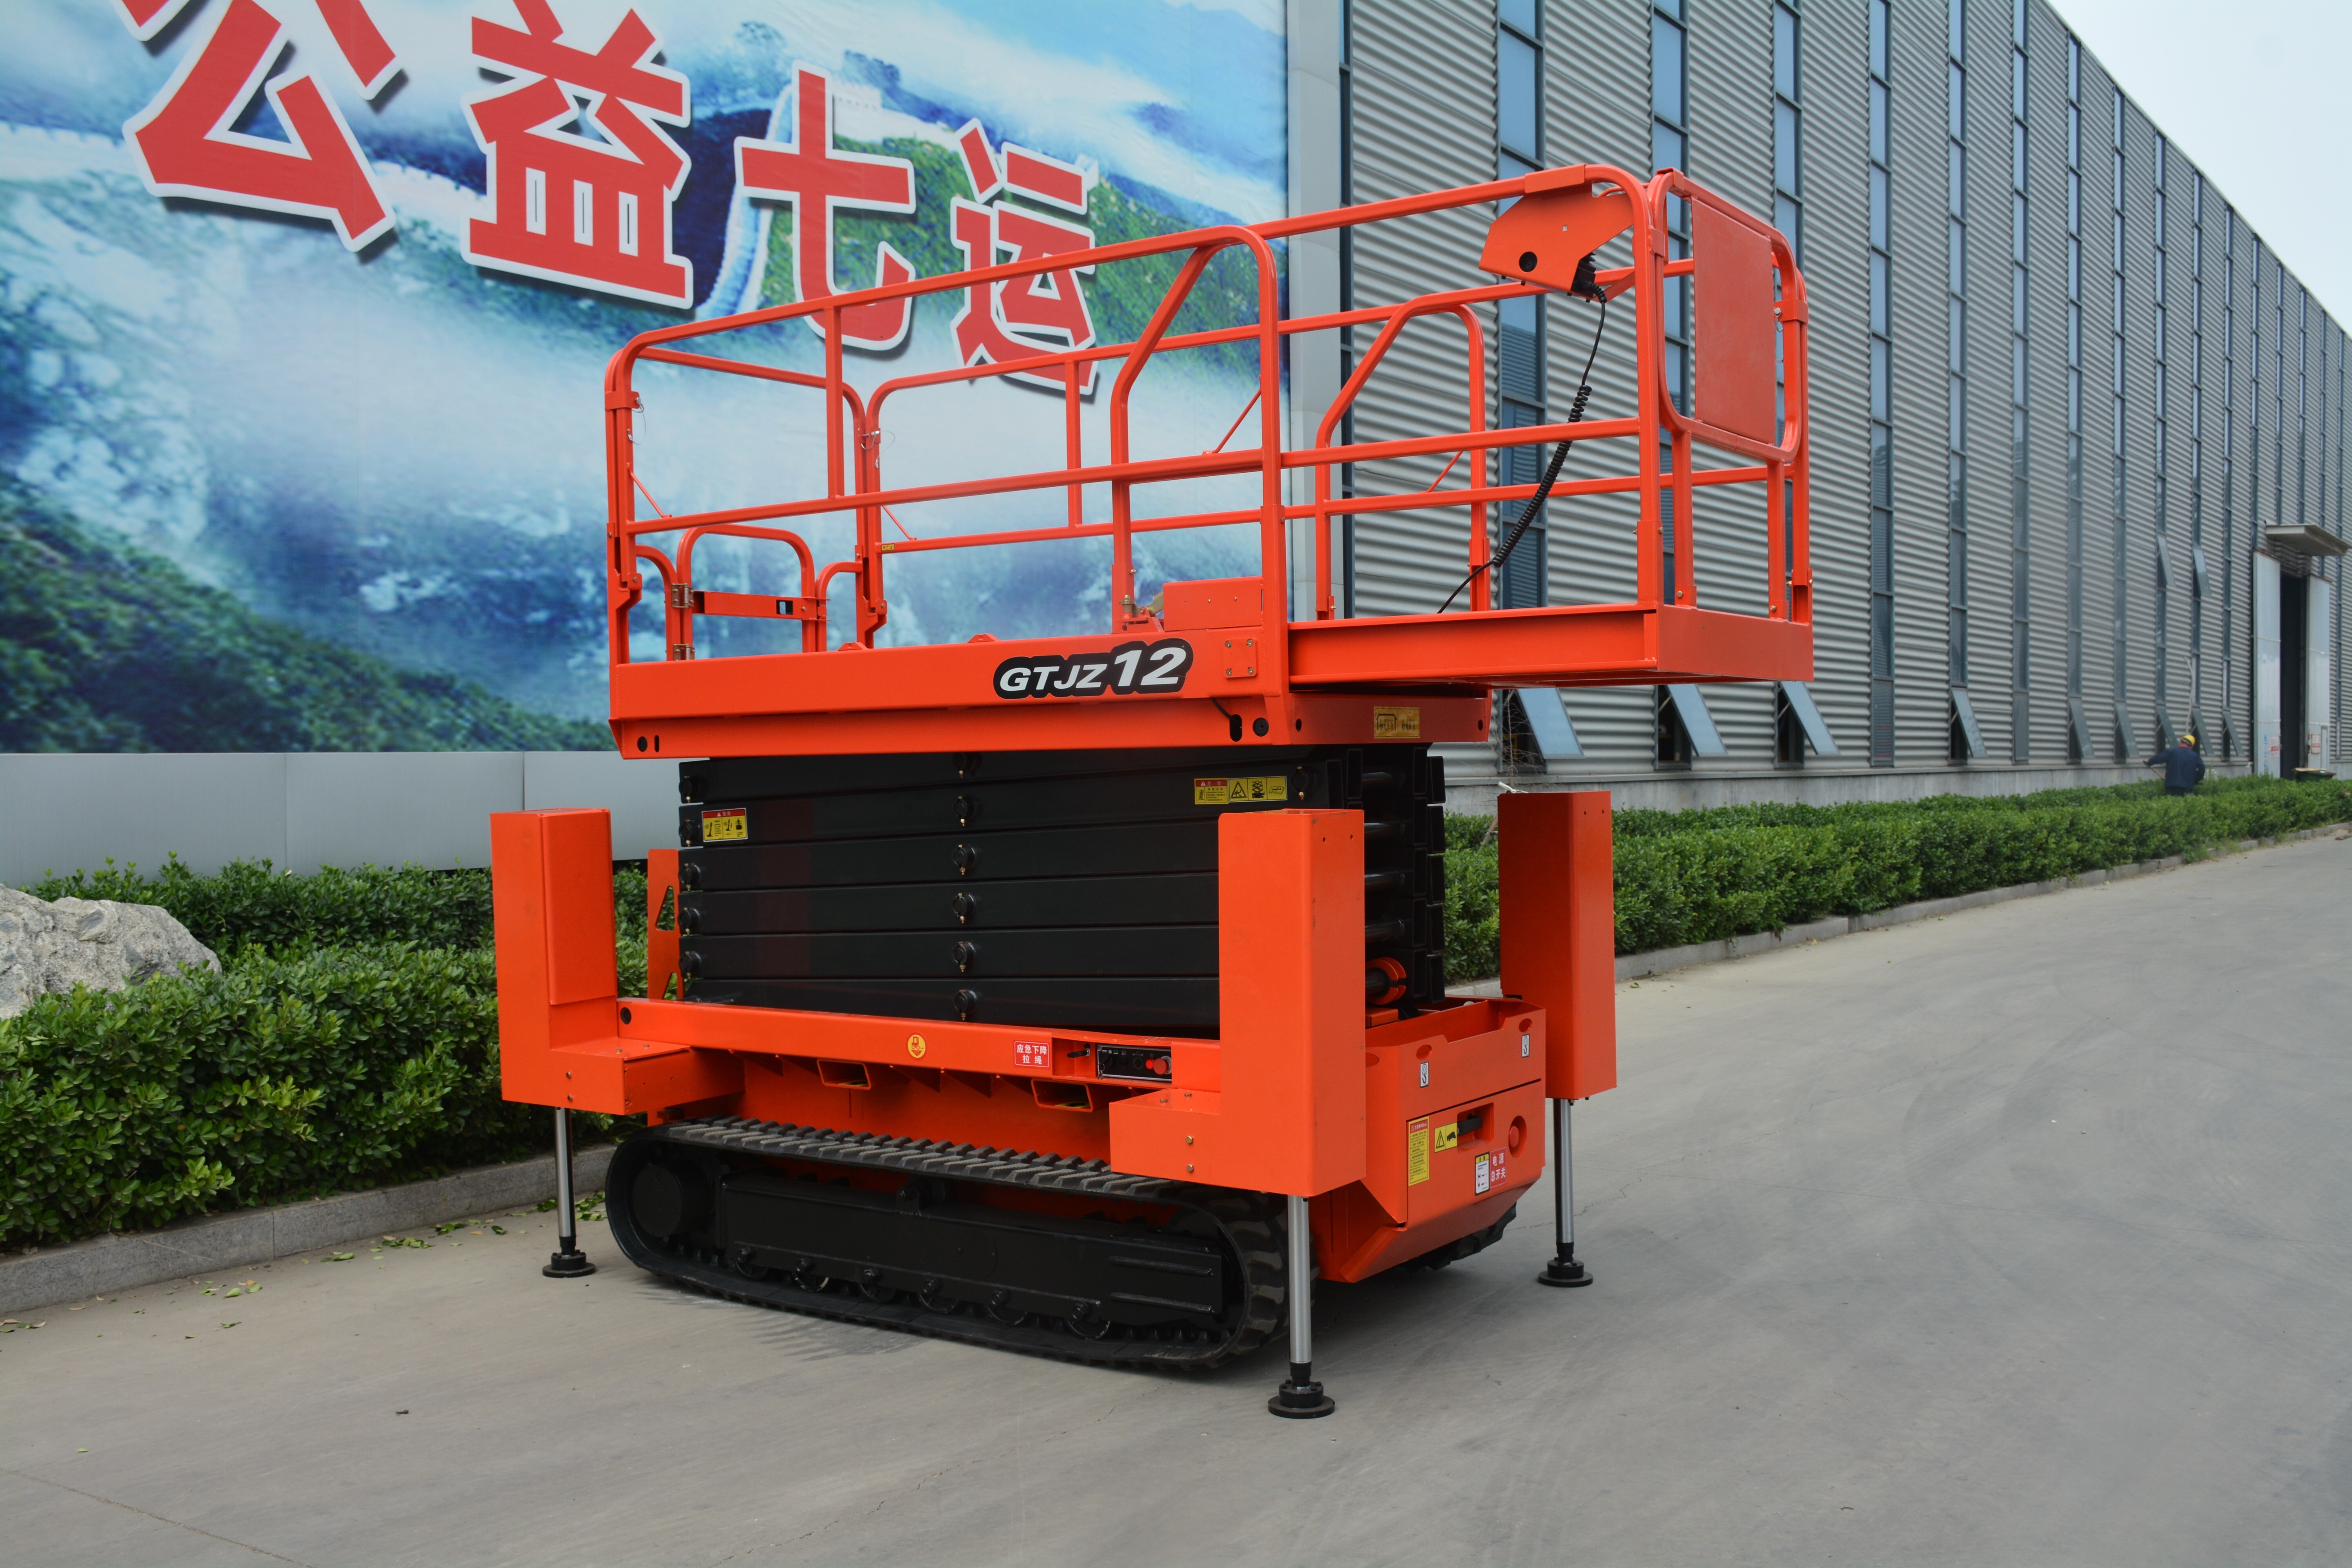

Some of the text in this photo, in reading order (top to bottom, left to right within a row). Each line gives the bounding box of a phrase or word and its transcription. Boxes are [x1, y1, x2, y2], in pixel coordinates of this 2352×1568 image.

[1016, 1044, 1047, 1055] 应急下降
[1022, 1054, 1042, 1065] 拉绳
[1492, 1152, 1504, 1166] 电源
[1490, 1167, 1506, 1182] 总开关
